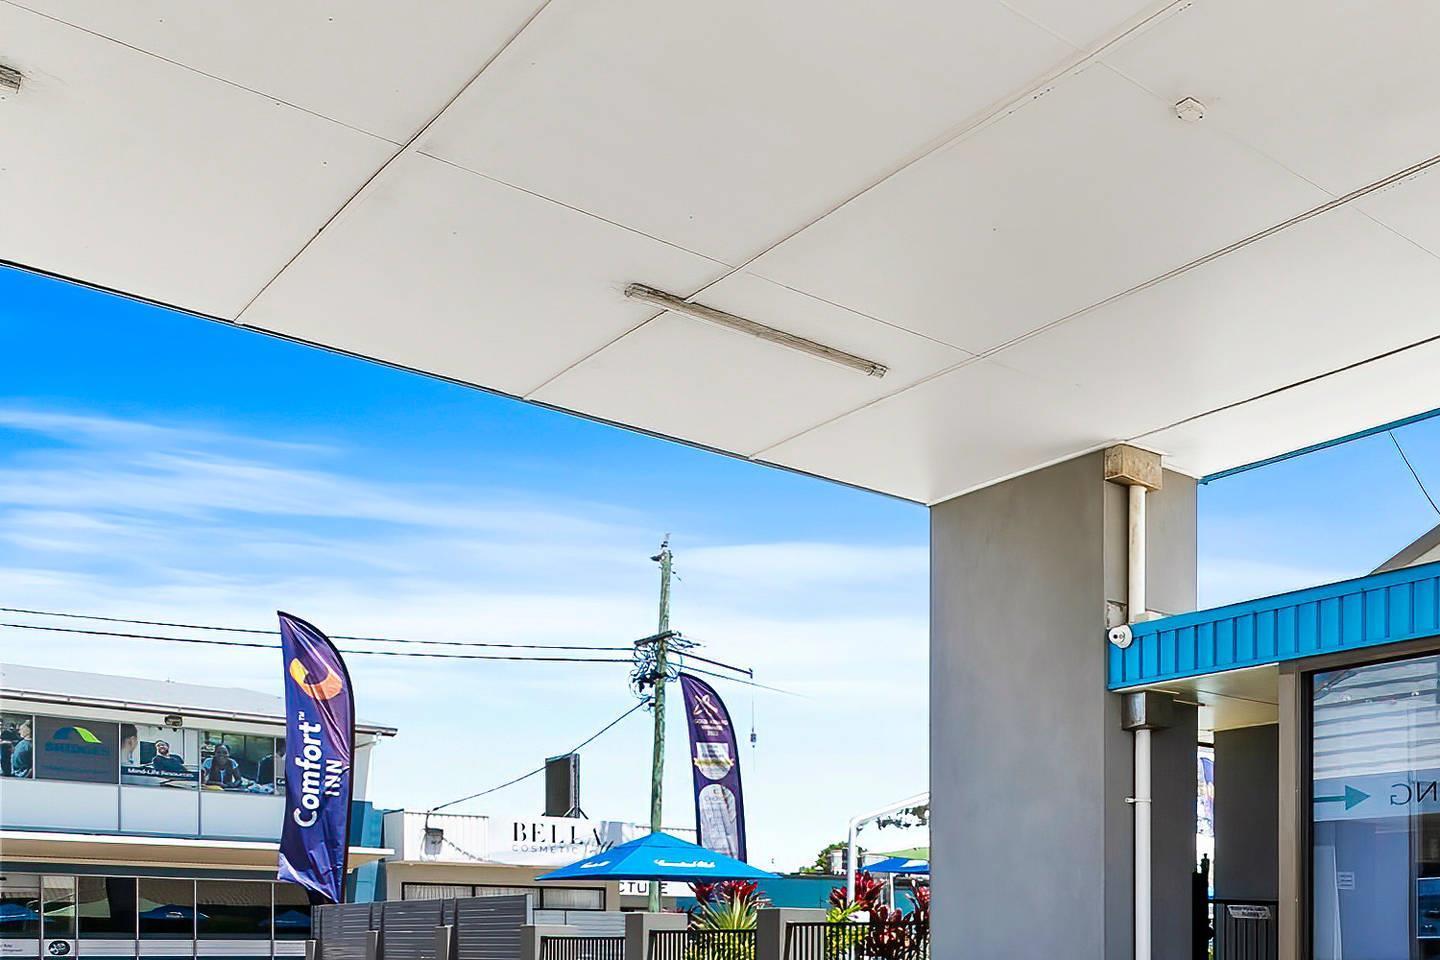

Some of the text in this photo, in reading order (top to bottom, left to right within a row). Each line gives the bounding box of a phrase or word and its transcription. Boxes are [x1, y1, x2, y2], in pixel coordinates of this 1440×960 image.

[293, 721, 322, 827] Comfort
[324, 759, 343, 797] INN
[512, 821, 602, 846] BELLA
[619, 881, 668, 894] CTUE
